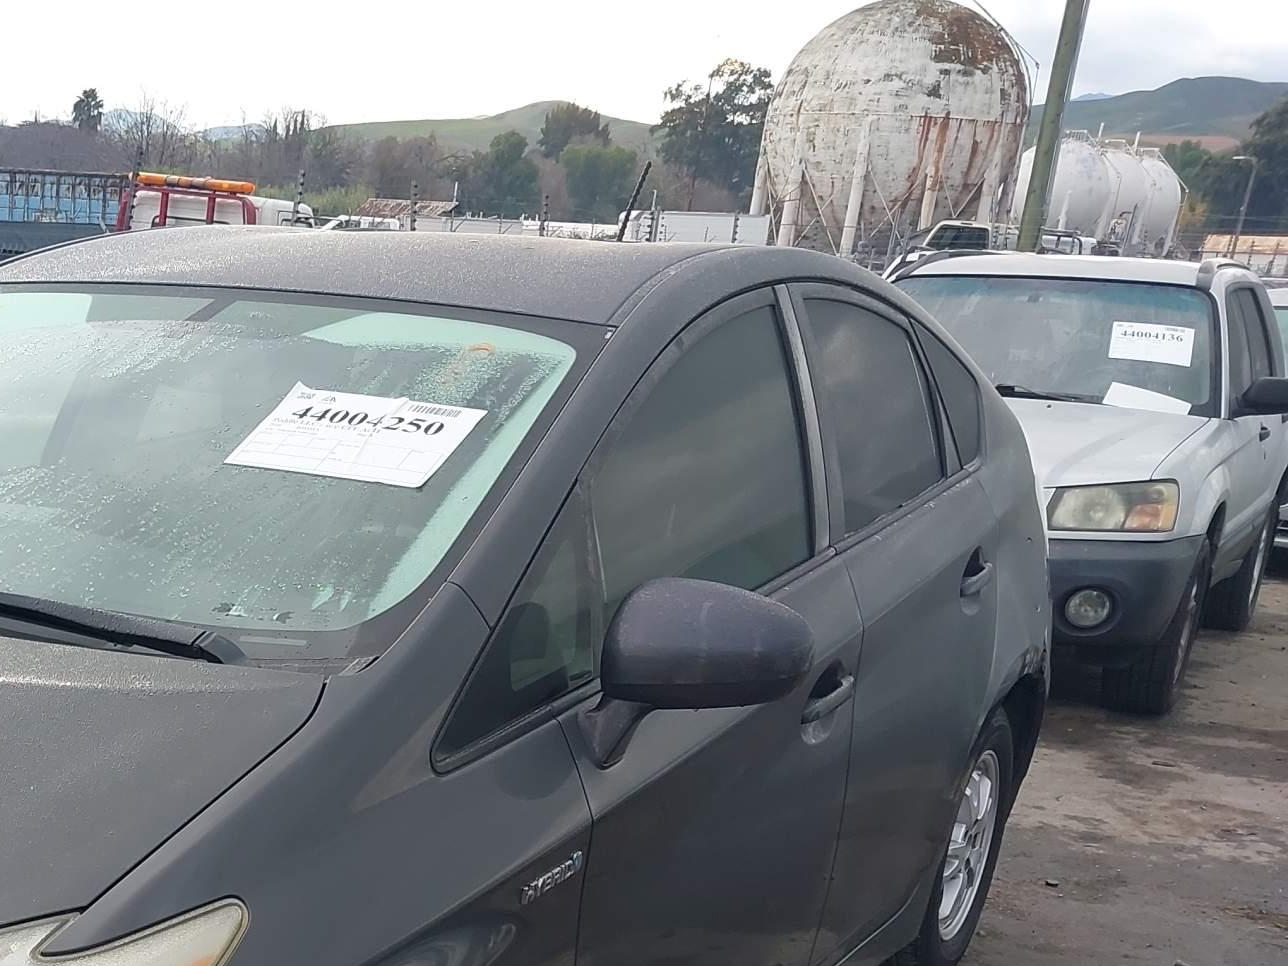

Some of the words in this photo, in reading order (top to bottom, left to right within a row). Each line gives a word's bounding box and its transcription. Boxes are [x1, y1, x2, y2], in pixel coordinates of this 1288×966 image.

[1120, 329, 1184, 343] 44004136
[291, 405, 445, 437] 44004250
[520, 850, 583, 905] HYBRID
